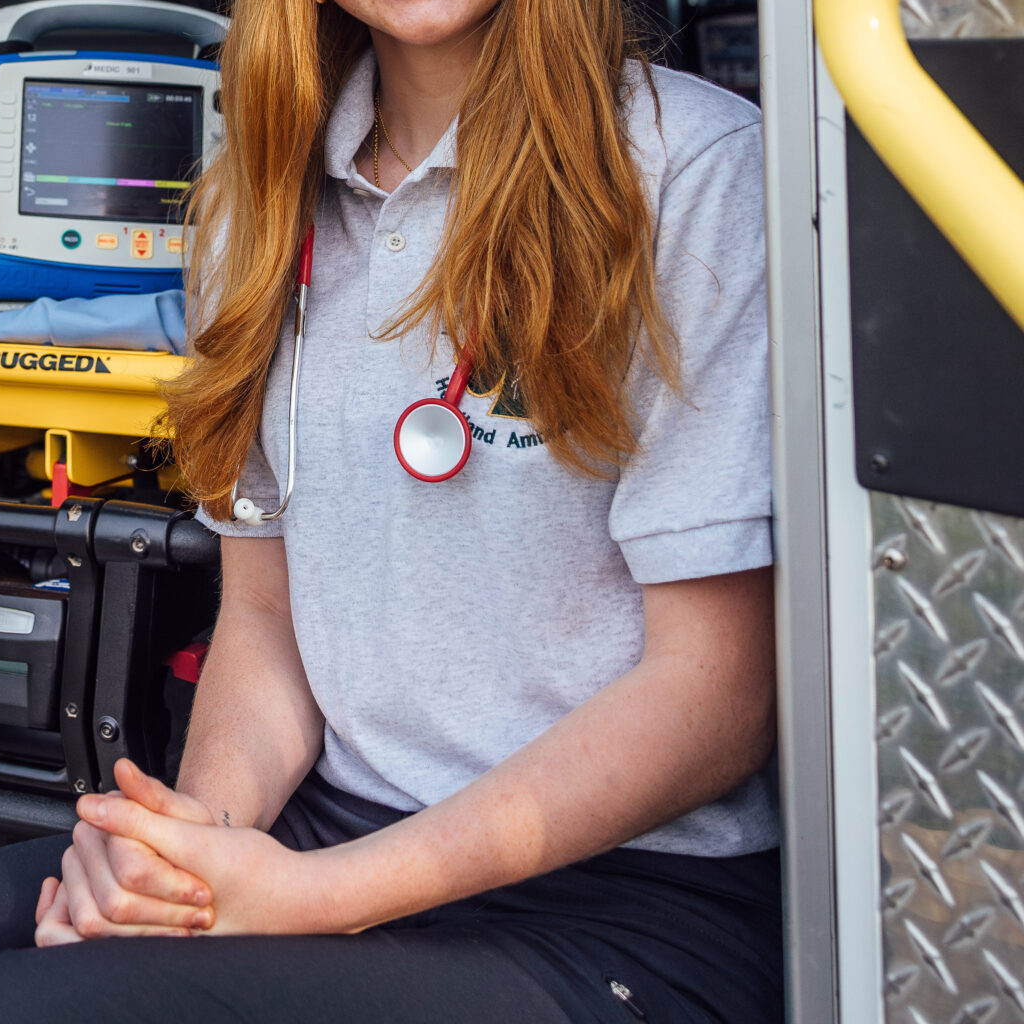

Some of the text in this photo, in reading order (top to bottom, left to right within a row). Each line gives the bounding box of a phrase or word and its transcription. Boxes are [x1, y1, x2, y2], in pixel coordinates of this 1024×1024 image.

[93, 64, 120, 74] MEDIC
[123, 227, 165, 237] 1 2
